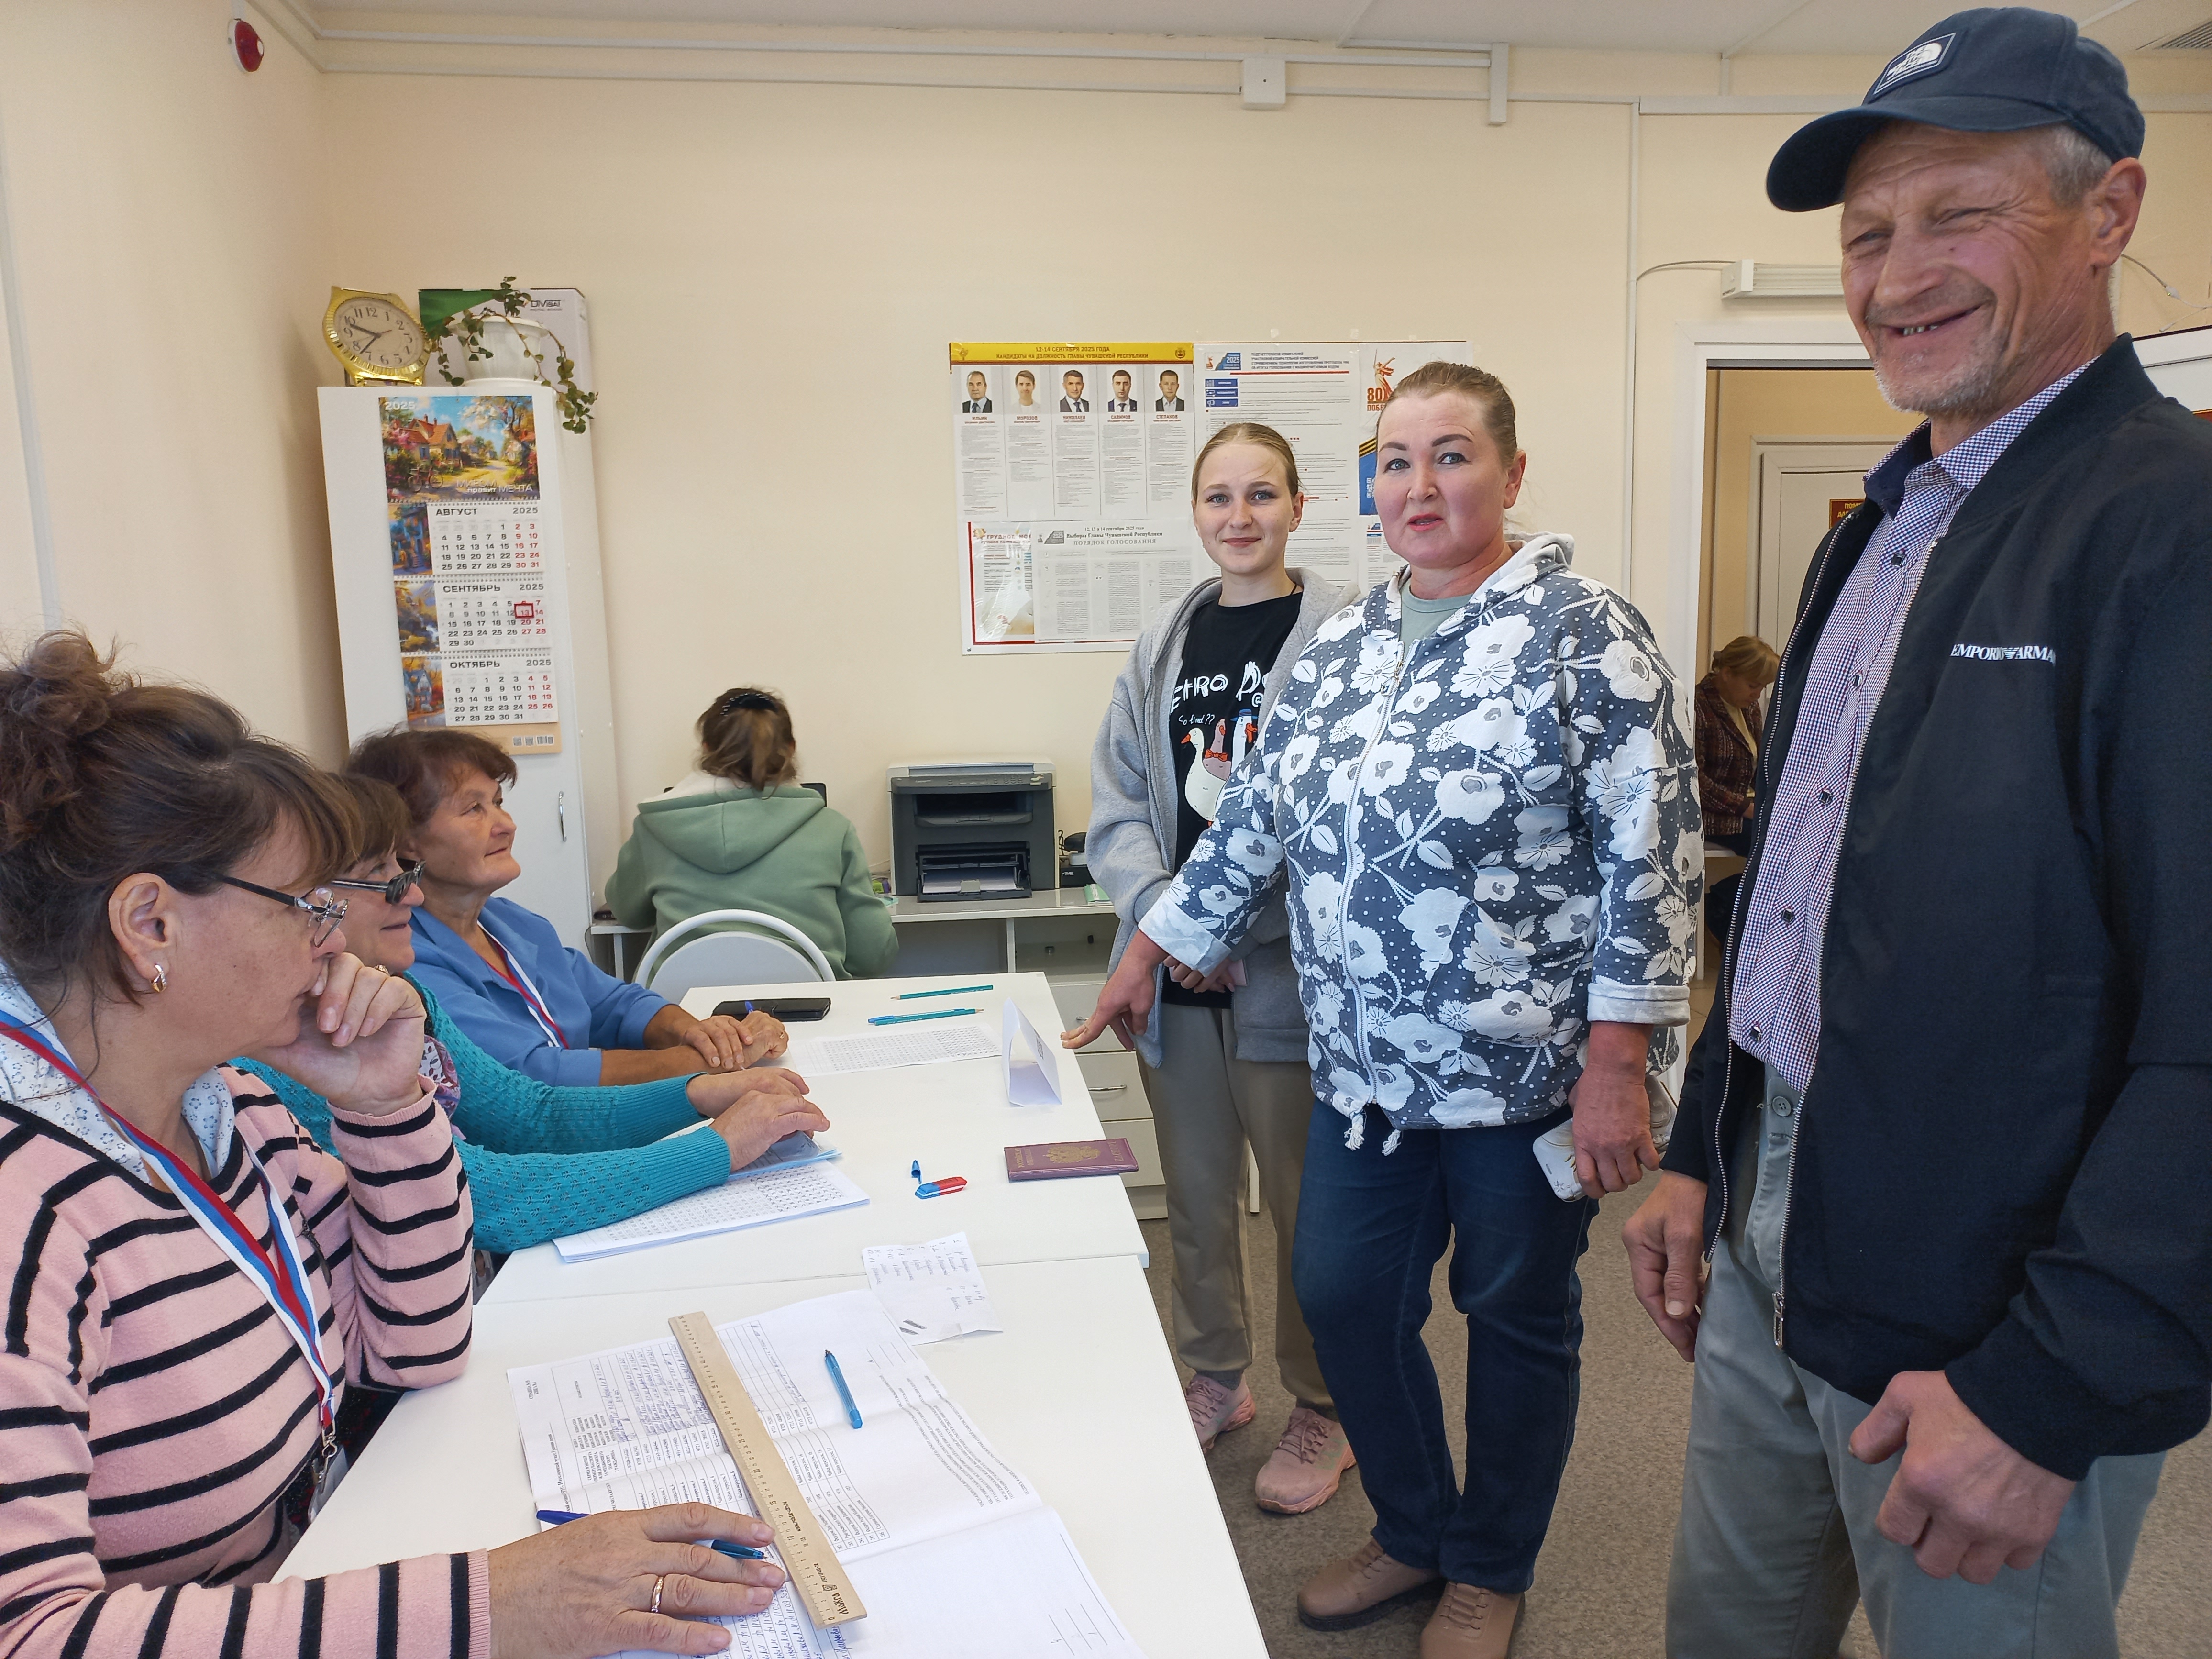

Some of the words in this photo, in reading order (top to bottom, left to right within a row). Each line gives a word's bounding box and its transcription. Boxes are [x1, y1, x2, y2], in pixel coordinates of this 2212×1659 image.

[354, 308, 363, 318] 11
[366, 307, 378, 317] 12
[385, 311, 389, 321] 1
[344, 316, 355, 325] 10
[396, 320, 404, 330] 2
[344, 327, 353, 338] 9
[353, 341, 361, 351] 8
[365, 351, 372, 360] 7
[380, 355, 389, 365] 6
[1367, 387, 1382, 401] 80
[384, 401, 416, 410] 2025
[457, 479, 497, 487] МИРОМ
[498, 484, 533, 493] МЕЧТА
[1950, 643, 2004, 660] EMPORIO
[2015, 646, 2056, 665] ARMA
[450, 661, 500, 669] ОКТЯБРЬ
